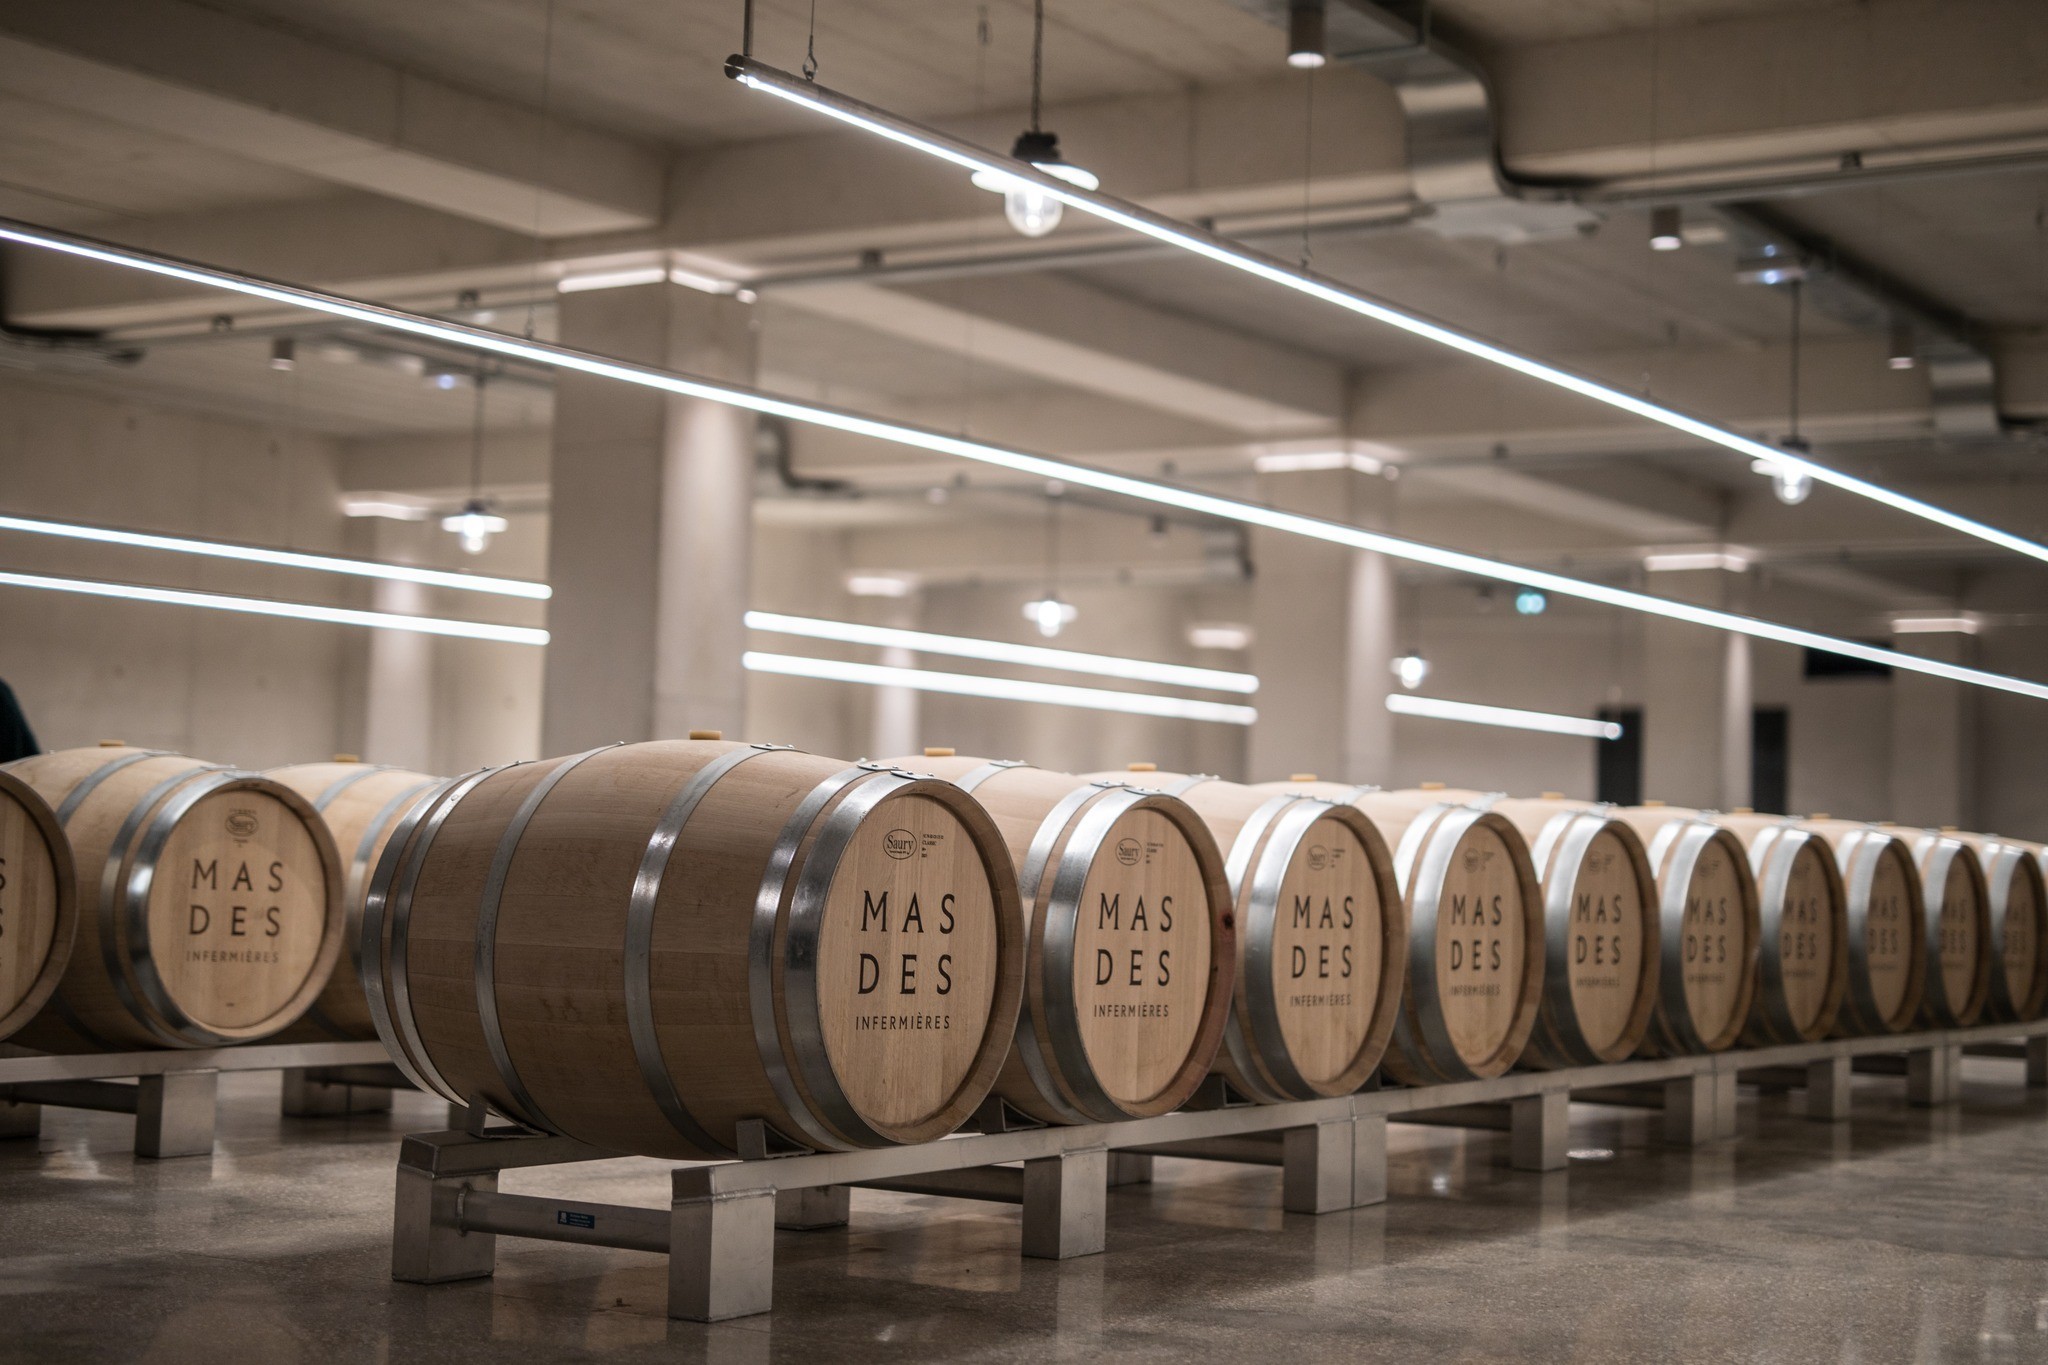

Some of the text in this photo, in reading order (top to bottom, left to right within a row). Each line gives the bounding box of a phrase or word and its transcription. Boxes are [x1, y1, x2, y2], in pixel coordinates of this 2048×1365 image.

[886, 835, 914, 851] Saury
[192, 858, 284, 893] MAS
[189, 904, 280, 937] DES
[860, 890, 955, 934] MAS
[1098, 892, 1173, 932] MAS
[1293, 894, 1354, 929] MAS
[1452, 894, 1502, 926] MAS
[1577, 894, 1622, 924] MAS
[1687, 897, 1727, 926] MAS
[186, 948, 279, 964] INFERMIÈRES
[1292, 945, 1352, 979] DES
[1451, 939, 1501, 971] DES
[1576, 935, 1621, 965] DES
[1687, 934, 1726, 963] DES
[858, 953, 952, 994] DES
[1095, 949, 1171, 986] DES
[856, 1011, 950, 1030] INFERMIÈRES
[1094, 1002, 1169, 1018] INFERMIÈRES
